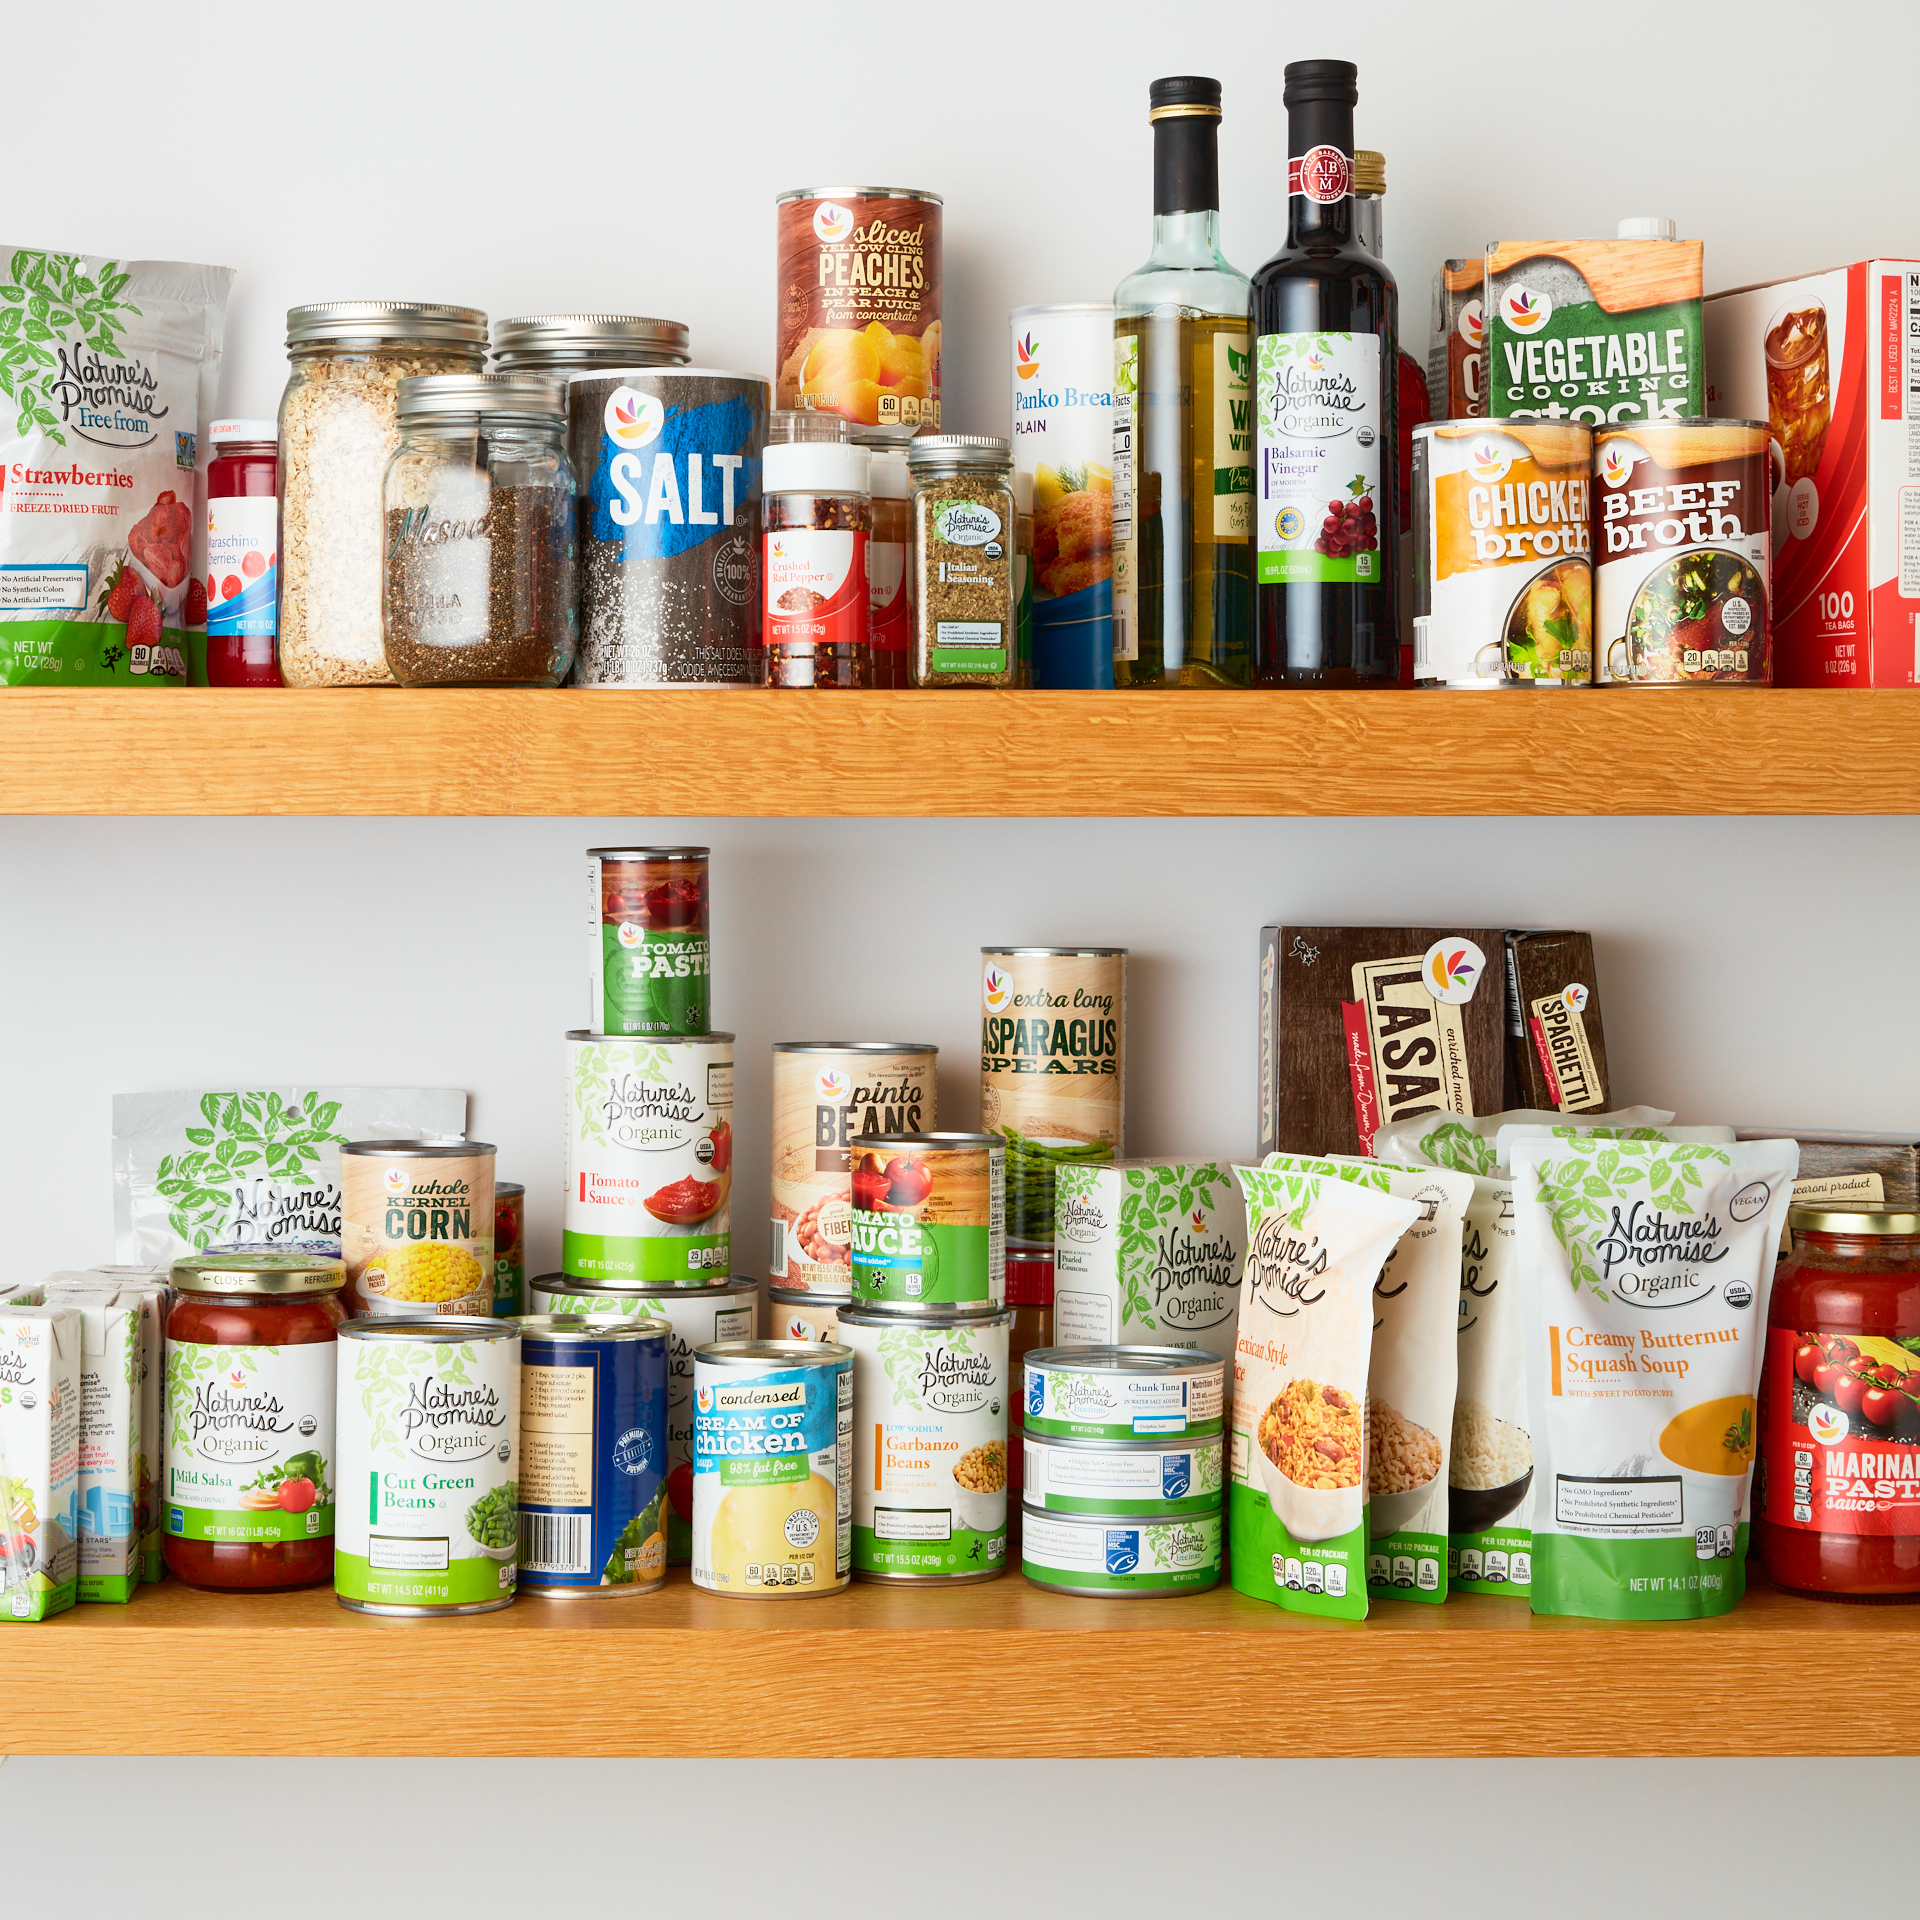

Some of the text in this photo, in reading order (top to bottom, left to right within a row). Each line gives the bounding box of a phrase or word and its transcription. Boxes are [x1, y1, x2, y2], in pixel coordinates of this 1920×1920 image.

[853, 219, 924, 246] sliced
[820, 243, 924, 255] YELLOW CLING
[819, 253, 924, 289] PEACHES
[824, 287, 919, 299] IN PEACH &
[821, 299, 921, 310] PEAR JUICE
[825, 307, 918, 324] from concentrate
[1889, 298, 1899, 332] MAR2224
[1889, 333, 1898, 342] BY
[1503, 328, 1687, 385] VEGETABLE
[1889, 342, 1898, 363] USED
[57, 342, 158, 391] Nature's
[1274, 365, 1357, 396] Nature's
[1507, 374, 1690, 401] COOKING
[1889, 375, 1898, 393] BEST
[51, 381, 169, 422] Promise
[1015, 389, 1059, 411] Panko
[1270, 392, 1366, 421] Promise
[79, 407, 150, 433] Free from
[1015, 419, 1047, 435] PLAIN
[1283, 413, 1344, 432] Organic
[1271, 447, 1326, 460] Balsamic
[10, 463, 134, 488] Strawberries
[1270, 462, 1318, 477] Vinegar
[609, 452, 743, 526] SALT
[10, 503, 120, 516] FREEZE DRIED FRUIT
[1467, 479, 1590, 529] CHICKEN
[1603, 480, 1741, 521] BEEF
[1797, 501, 1809, 510] HOT
[1603, 508, 1747, 553] broth
[1796, 518, 1810, 527] ICED
[952, 533, 983, 542] Organic
[1471, 523, 1590, 560] broth
[772, 561, 810, 572] Crushed
[946, 562, 977, 572] Italian
[773, 573, 825, 584] Red Pepper
[946, 573, 994, 586] Seasoning
[1818, 590, 1854, 620] 100
[1825, 620, 1854, 630] TEA BAGS
[14, 641, 54, 654] NET WT
[639, 940, 709, 956] TOMATO
[1013, 987, 1114, 1016] extra long
[981, 1017, 1117, 1057] ASPARAGUS
[1542, 1000, 1591, 1105] SPAGHETTI
[981, 1057, 1117, 1075] SPEARS
[610, 1073, 696, 1105] Nature's
[850, 1078, 924, 1107] pinto
[602, 1102, 704, 1130] Promise
[815, 1105, 922, 1147] BEANS
[618, 1124, 683, 1144] Organic
[411, 1179, 470, 1195] whole
[589, 1173, 640, 1188] Tomato
[1830, 1177, 1872, 1195] product
[235, 1178, 342, 1221] Nature's
[386, 1197, 471, 1208] KERNEL
[588, 1190, 625, 1205] Sauce
[1411, 1184, 1449, 1204] MICROWAVE
[1733, 1196, 1767, 1207] VEGAN
[385, 1208, 470, 1240] CORN
[1607, 1200, 1722, 1244] Nature's
[1069, 1227, 1097, 1238] Organic
[1157, 1226, 1237, 1269] Nature's
[1253, 1213, 1331, 1275] Nature's
[1061, 1254, 1082, 1264] Pearled
[1061, 1263, 1088, 1273] Couscous
[1595, 1238, 1730, 1280] Promise
[214, 1275, 244, 1286] CLOSE
[304, 1272, 341, 1285] REFRIGERATE
[366, 1273, 386, 1283] VACUUM
[368, 1280, 386, 1289] PACKED
[1150, 1261, 1243, 1307] Promise
[1247, 1253, 1326, 1306] Promise
[1618, 1268, 1700, 1299] Organic
[1166, 1292, 1225, 1320] Organic
[1566, 1326, 1740, 1351] Creamy Butternut
[924, 1347, 991, 1374] Nature's
[1264, 1339, 1289, 1371] Style
[1566, 1352, 1690, 1380] Squash Soup
[408, 1376, 500, 1411] Nature's
[918, 1371, 997, 1397] Promise
[1128, 1382, 1180, 1392] Chunk Tuna
[1567, 1389, 1675, 1398] WITH SWEET POTATO PUREE
[195, 1381, 284, 1414] Nature's
[720, 1386, 800, 1405] condensed
[932, 1389, 983, 1407] Organic
[189, 1410, 294, 1440] Promise
[399, 1407, 507, 1440] Promise
[696, 1412, 805, 1431] CREAM OF
[886, 1424, 943, 1434] LOW SODIUM
[203, 1435, 269, 1456] Organic
[418, 1430, 487, 1455] Organic
[696, 1429, 808, 1456] chicken
[886, 1436, 959, 1452] Garbanzo
[729, 1459, 798, 1478] 98% fat free
[886, 1453, 931, 1470] Beans
[1826, 1450, 1920, 1479] MARINA
[175, 1469, 233, 1487] Mild Salsa
[383, 1472, 475, 1490] Cut Green
[383, 1491, 436, 1509] Beans
[1825, 1496, 1876, 1512] sauce
[367, 1582, 449, 1598] NET WT 14.5 OZ (411g)
[1629, 1573, 1723, 1592] NET WT 14.1 OZ (400g)
